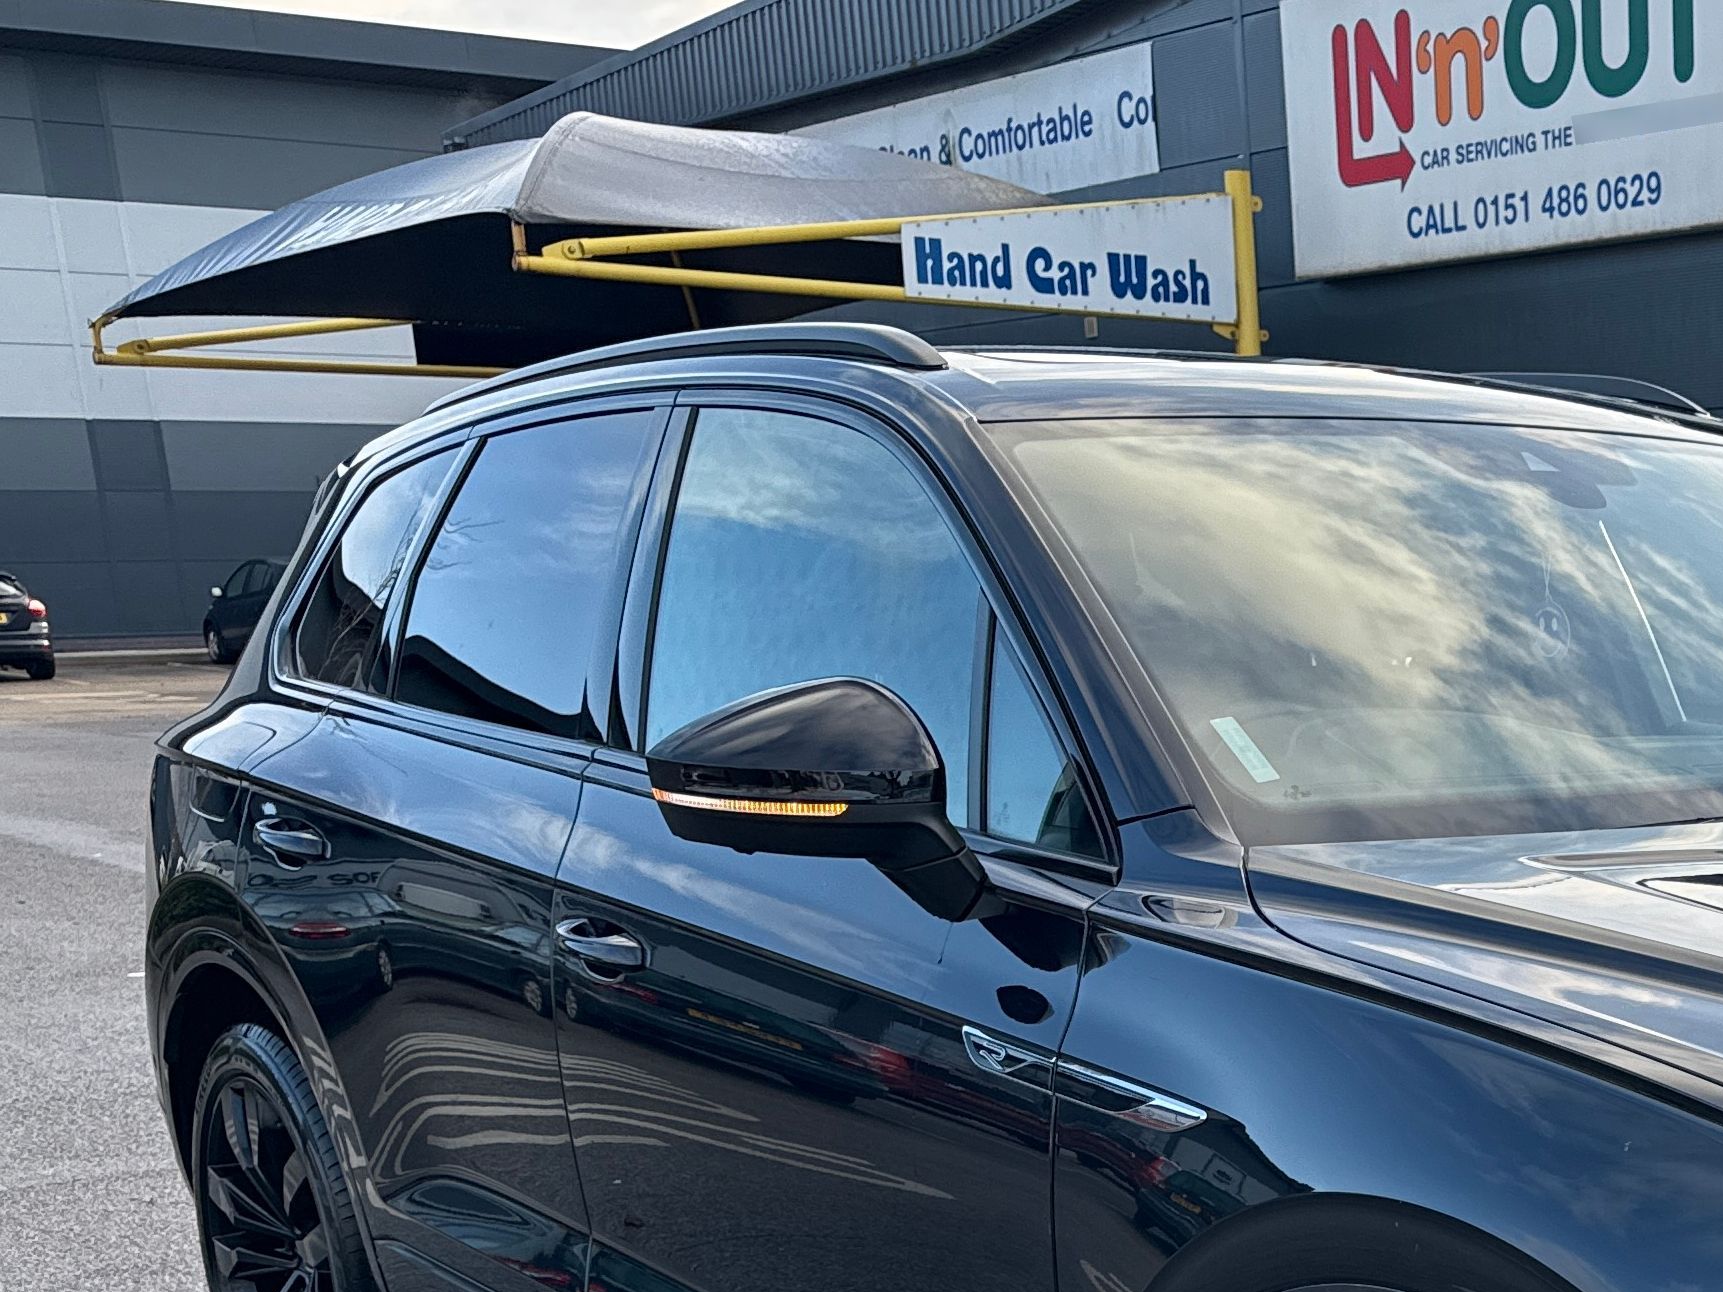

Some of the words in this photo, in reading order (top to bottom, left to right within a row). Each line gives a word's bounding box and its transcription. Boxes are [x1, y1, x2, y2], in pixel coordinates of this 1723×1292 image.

[939, 133, 953, 167] &
[958, 102, 1093, 163] Comfortable
[1420, 147, 1451, 171] CAR
[1455, 131, 1537, 165] SERVICING
[1541, 125, 1573, 150] THE
[1407, 200, 1468, 239] CALL
[1474, 190, 1530, 229] 0151
[1540, 182, 1588, 219] 486
[1596, 170, 1662, 212] 0629
[913, 236, 1012, 290] Hand
[1026, 246, 1097, 296] Car
[1106, 252, 1210, 306] Wash
